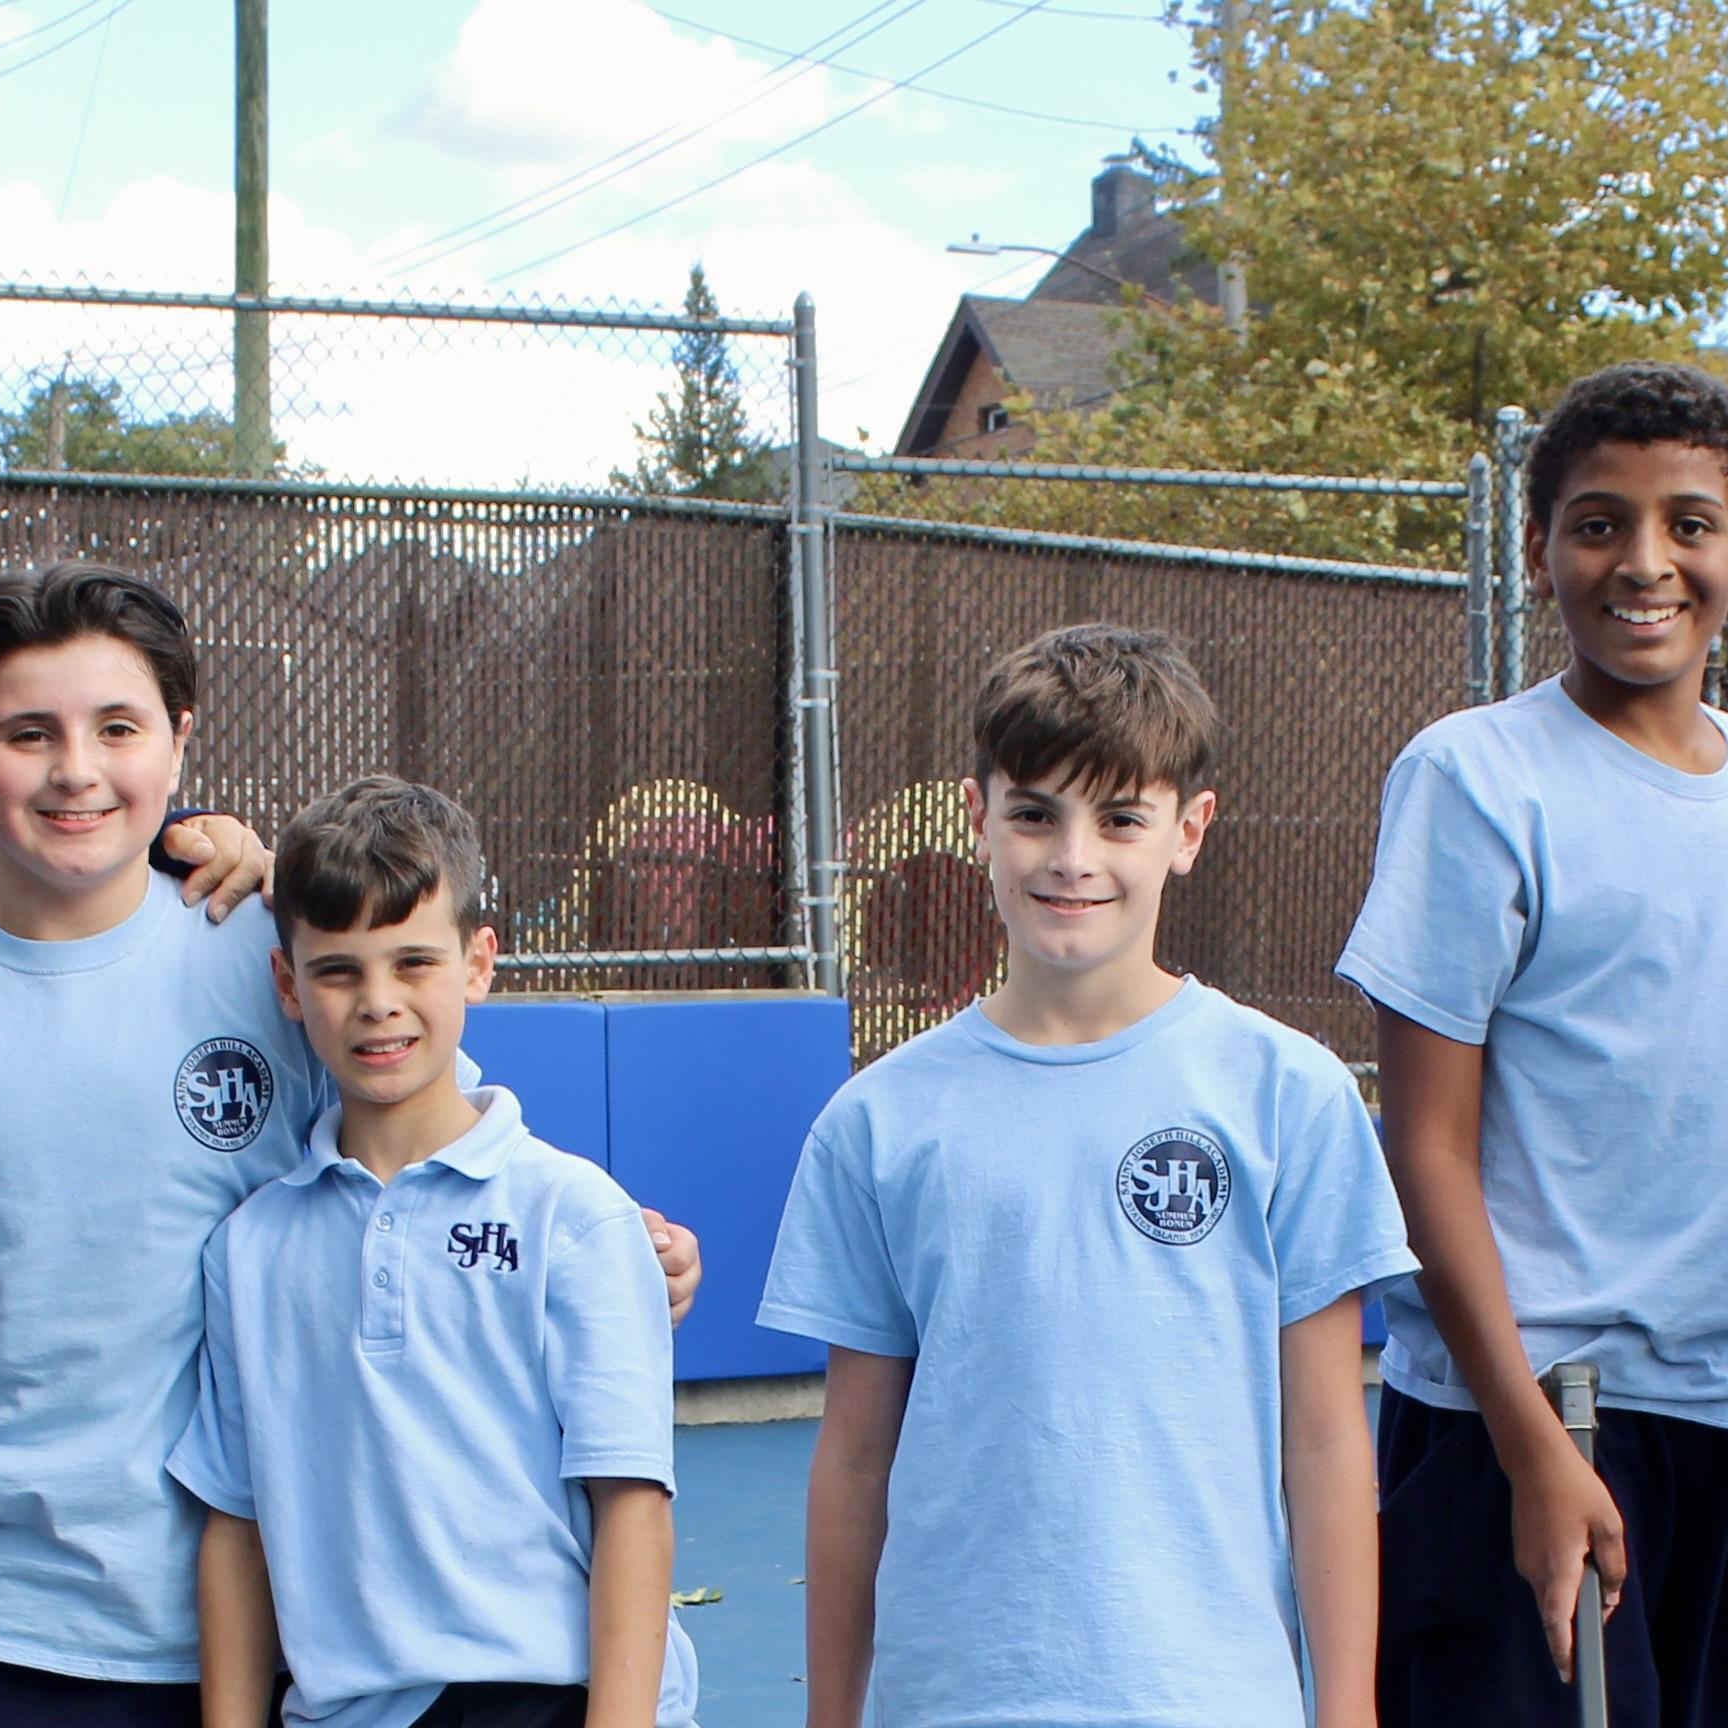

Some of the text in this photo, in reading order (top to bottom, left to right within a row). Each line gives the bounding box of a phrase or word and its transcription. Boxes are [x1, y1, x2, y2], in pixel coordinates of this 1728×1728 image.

[183, 1041, 218, 1072] JOSEPH
[219, 1040, 244, 1052] HILL
[186, 1067, 260, 1122] SJHA
[1121, 1131, 1228, 1201] SAINT JOSEPH HILL ACADEMY
[1129, 1158, 1212, 1215] SJHA
[447, 1222, 519, 1272] SJHA
